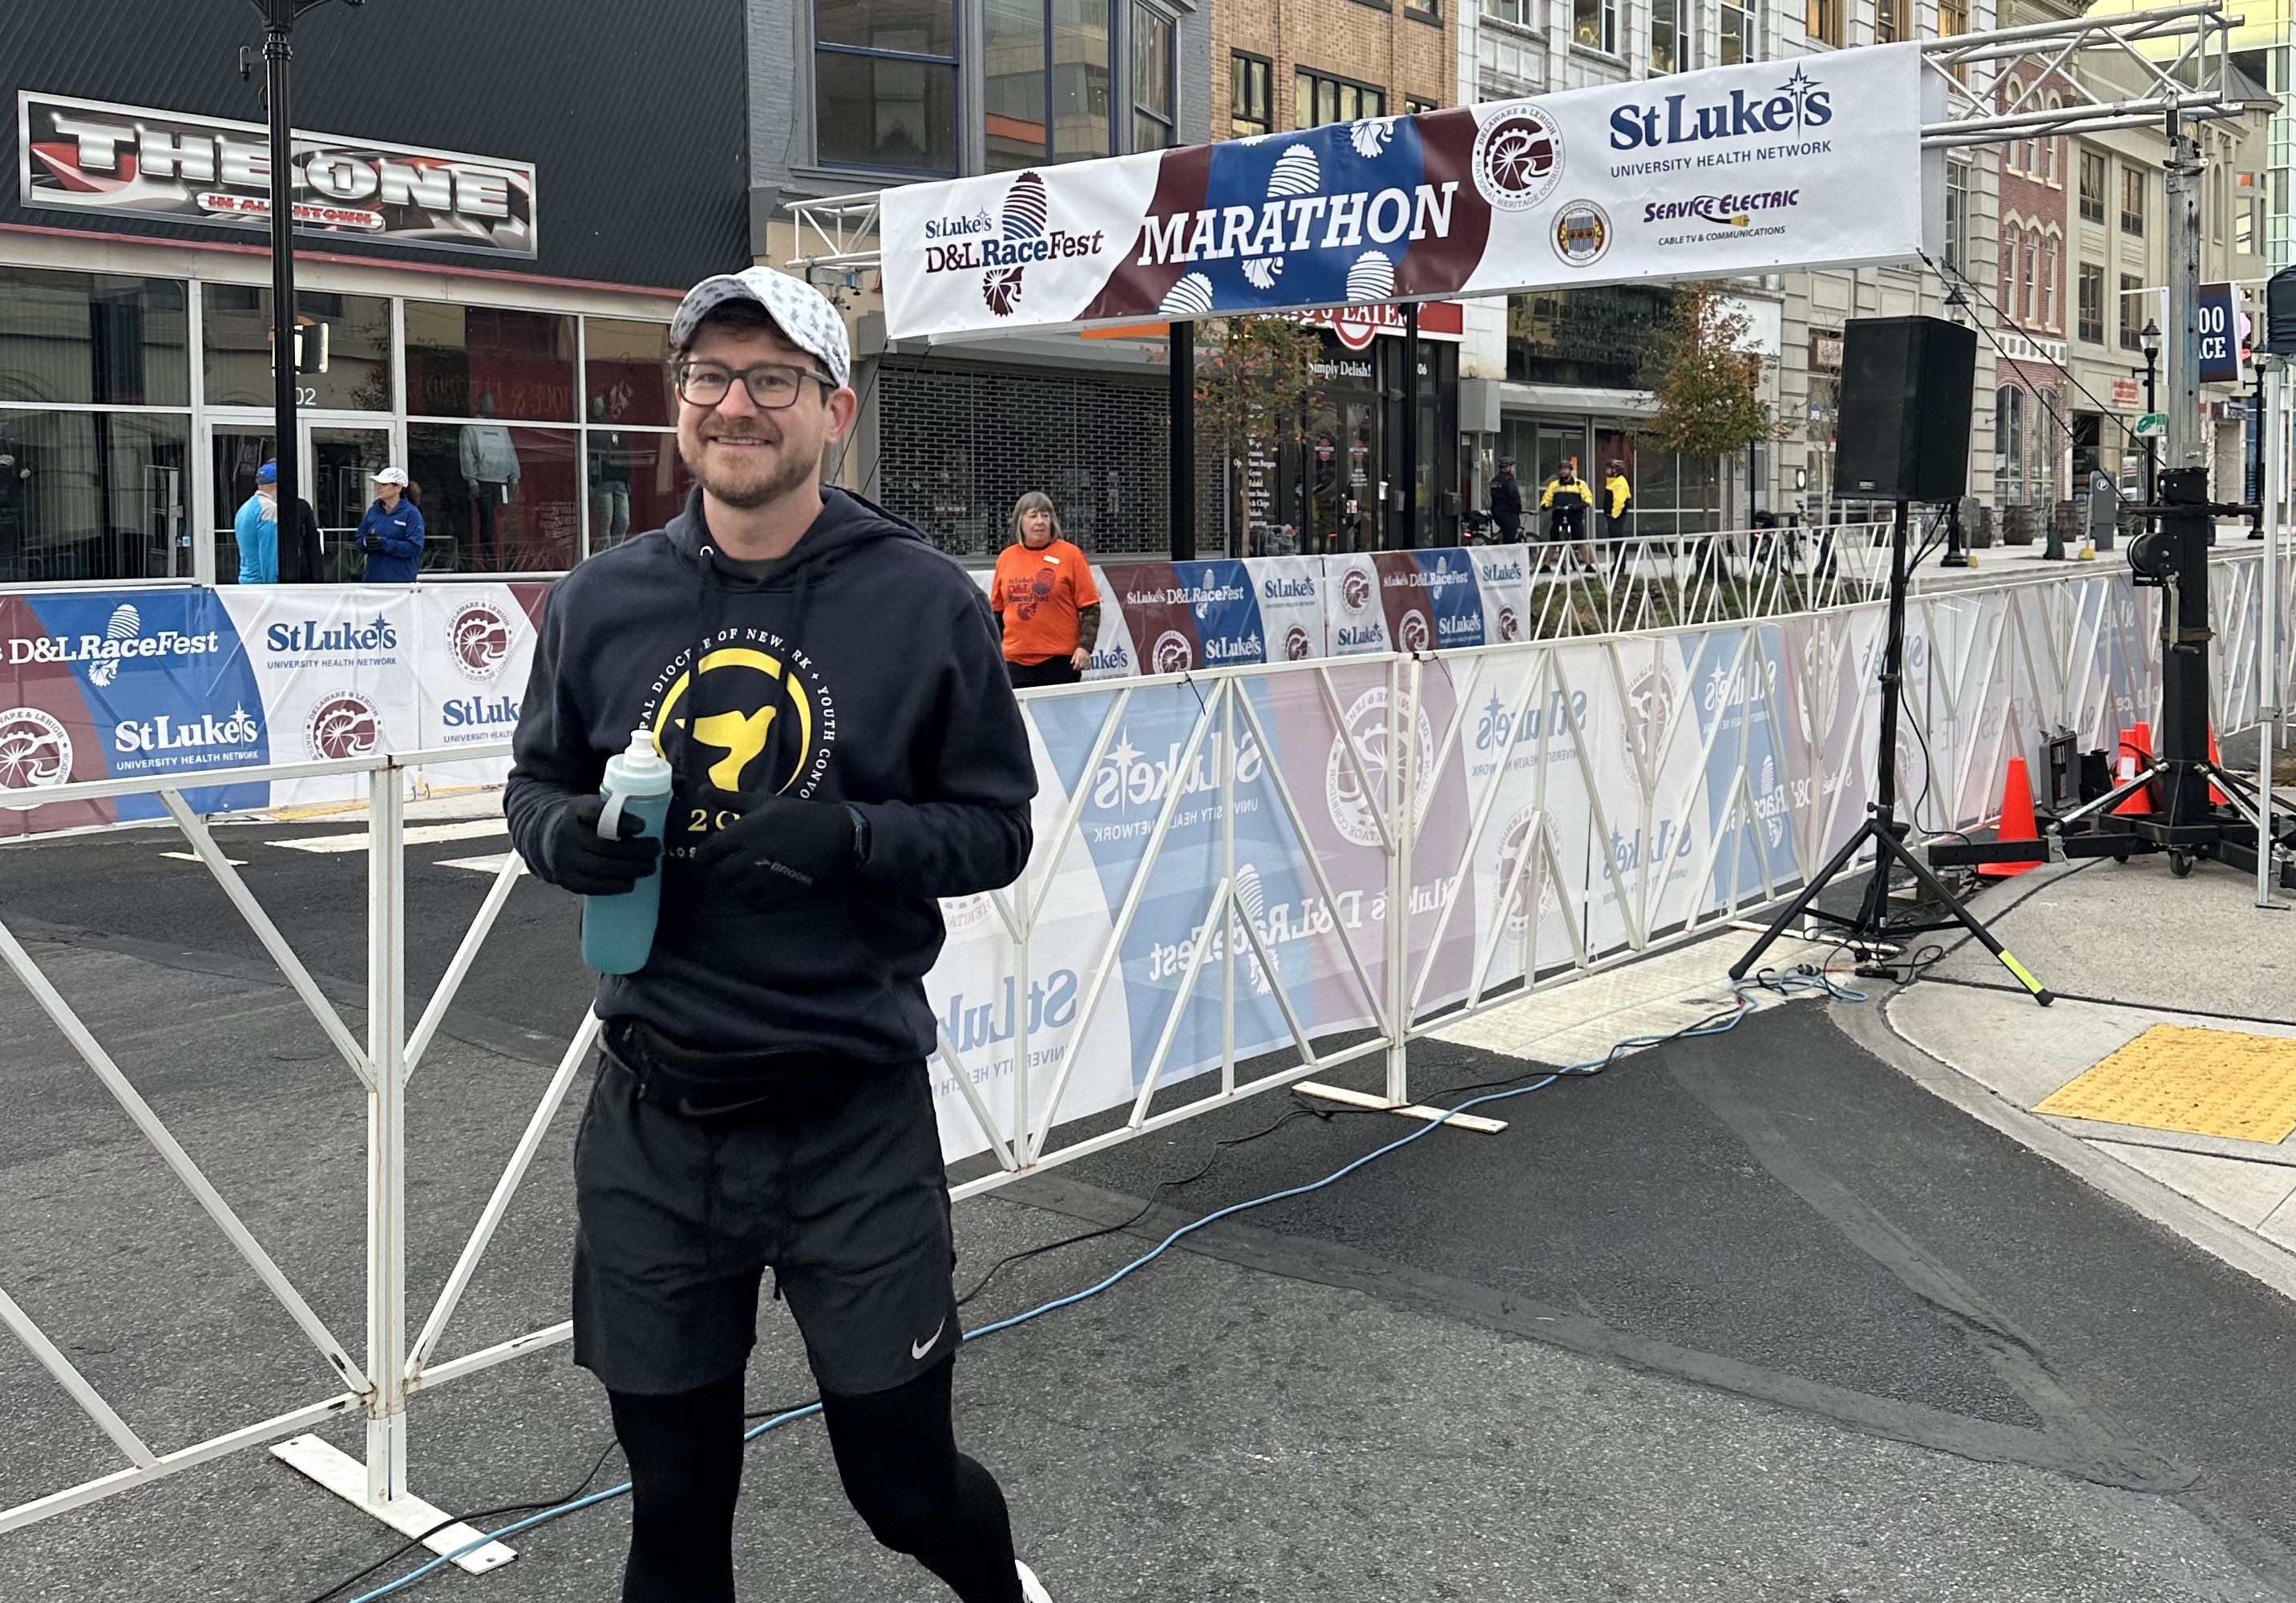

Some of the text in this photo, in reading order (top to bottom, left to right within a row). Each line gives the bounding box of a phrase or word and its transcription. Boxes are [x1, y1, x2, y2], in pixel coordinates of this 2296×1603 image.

[1477, 107, 1518, 145] DELAWARE
[1530, 108, 1557, 135] LEHIGH
[55, 117, 270, 188] THE
[1611, 139, 1833, 178] UNIVERSITY HEALTH NETWORK
[1475, 150, 1562, 208] NATIONAL HERITAGE CORRIDOR
[208, 195, 372, 224] IN ALNTOWN
[1137, 181, 1459, 266] MARATHON
[1659, 225, 1786, 246] CABLE TV & COMMUNICATIONS
[1340, 361, 1371, 378] Delish!
[447, 602, 479, 629] DELAWARE
[488, 604, 510, 628] LEHIGH
[268, 657, 397, 669] UNIVERSITY HEALTH NETWORK
[652, 638, 712, 693] DIOCEE
[718, 628, 738, 642] OF
[746, 628, 783, 648] NEW
[816, 685, 836, 741] YOUTH
[309, 690, 346, 721] DELAWARE
[356, 692, 379, 717] LEHIGH
[25, 711, 33, 719] &
[34, 713, 65, 740] LEHIGH
[444, 733, 489, 743] UNIVERSITY
[116, 750, 258, 771] UNIVERSITY HEALTH NETWORK
[668, 846, 697, 859] LOS
